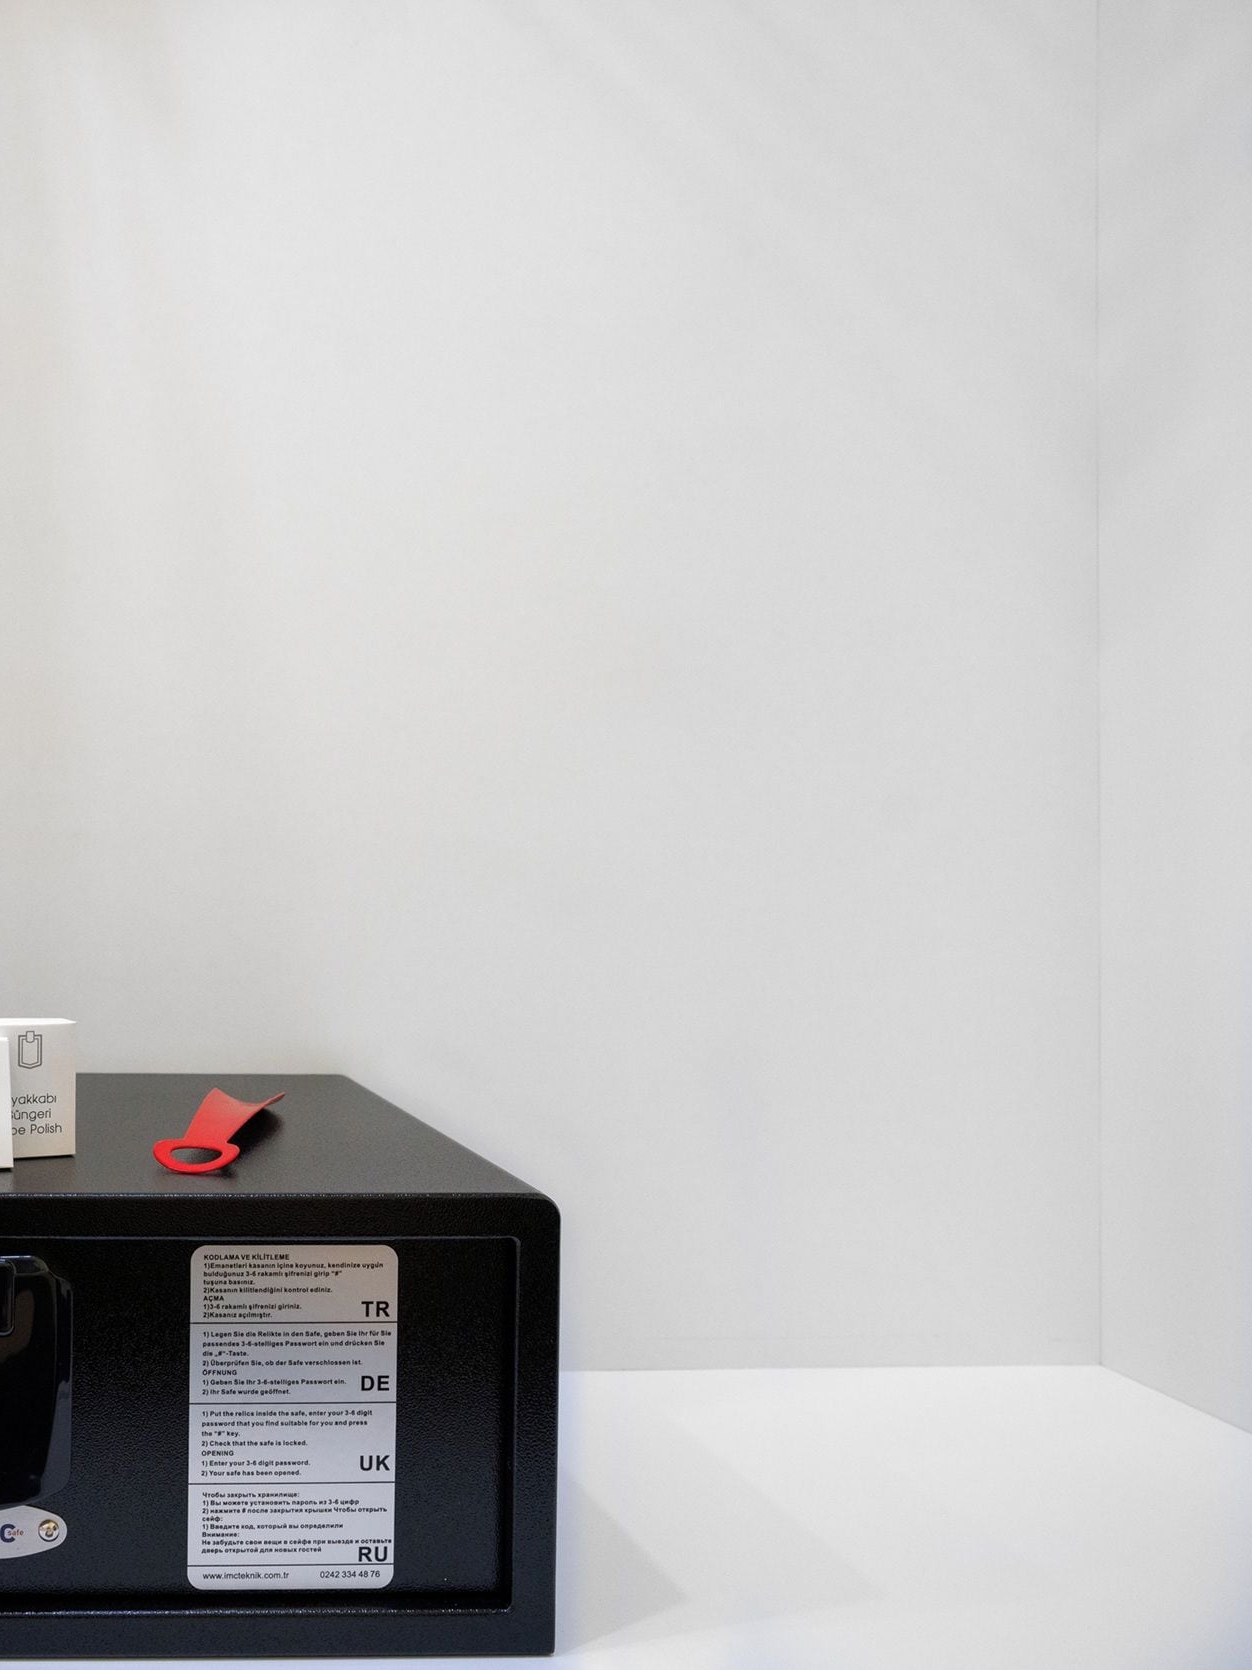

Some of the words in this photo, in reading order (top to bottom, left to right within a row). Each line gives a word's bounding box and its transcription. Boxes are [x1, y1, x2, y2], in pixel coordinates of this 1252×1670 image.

[11, 1093, 57, 1107] yakkabı
[30, 1124, 62, 1134] Polish
[360, 1301, 390, 1317] TR
[360, 1375, 389, 1391] DE
[359, 1454, 390, 1471] UK
[358, 1546, 387, 1562] RU
[202, 1571, 289, 1579] www.imcteknik.com.tr
[319, 1570, 340, 1578] 0242
[340, 1570, 356, 1578] 334
[357, 1570, 368, 1578] 48
